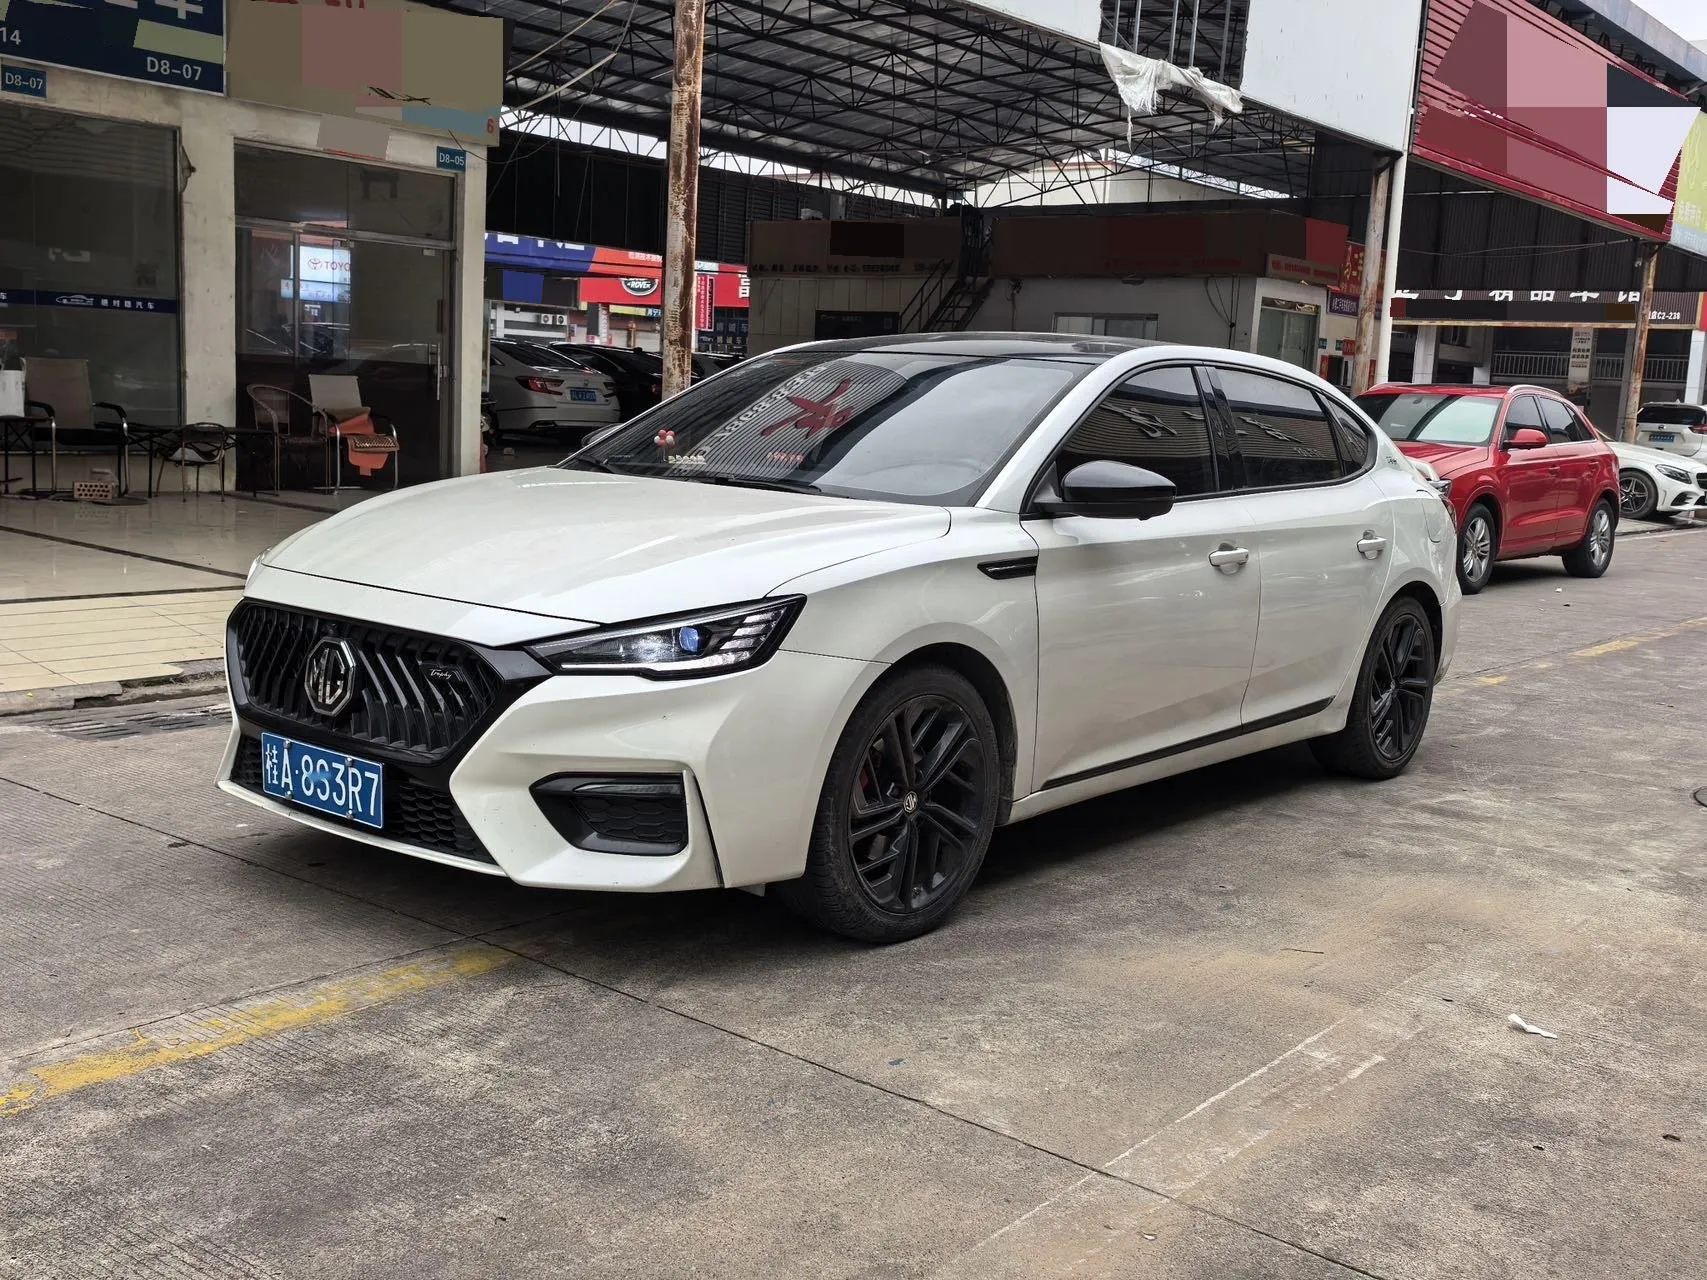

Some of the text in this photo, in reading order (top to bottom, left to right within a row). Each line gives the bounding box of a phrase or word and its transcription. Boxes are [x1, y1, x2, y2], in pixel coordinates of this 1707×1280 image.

[147, 56, 203, 81] D8-07
[5, 72, 43, 90] D8-07
[439, 152, 465, 166] D8-05
[311, 648, 346, 706] MG
